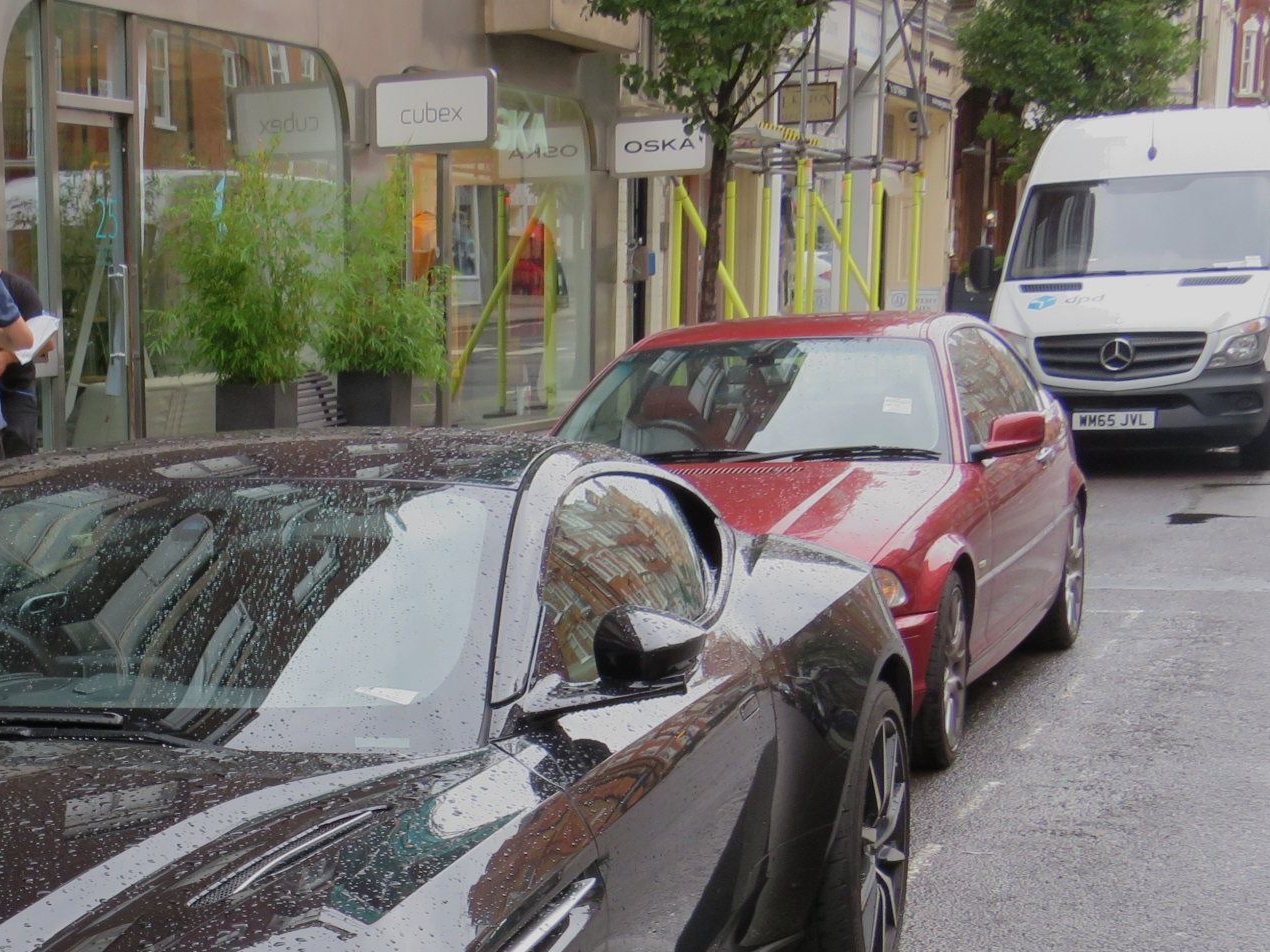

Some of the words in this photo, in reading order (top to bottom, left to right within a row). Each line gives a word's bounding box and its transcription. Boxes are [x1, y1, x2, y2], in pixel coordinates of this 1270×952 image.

[401, 101, 463, 125] cubex
[624, 138, 696, 154] OSKA
[95, 197, 118, 239] 25
[1064, 294, 1106, 305] dpd
[1079, 414, 1116, 427] WM65
[1120, 412, 1148, 427] JVL
